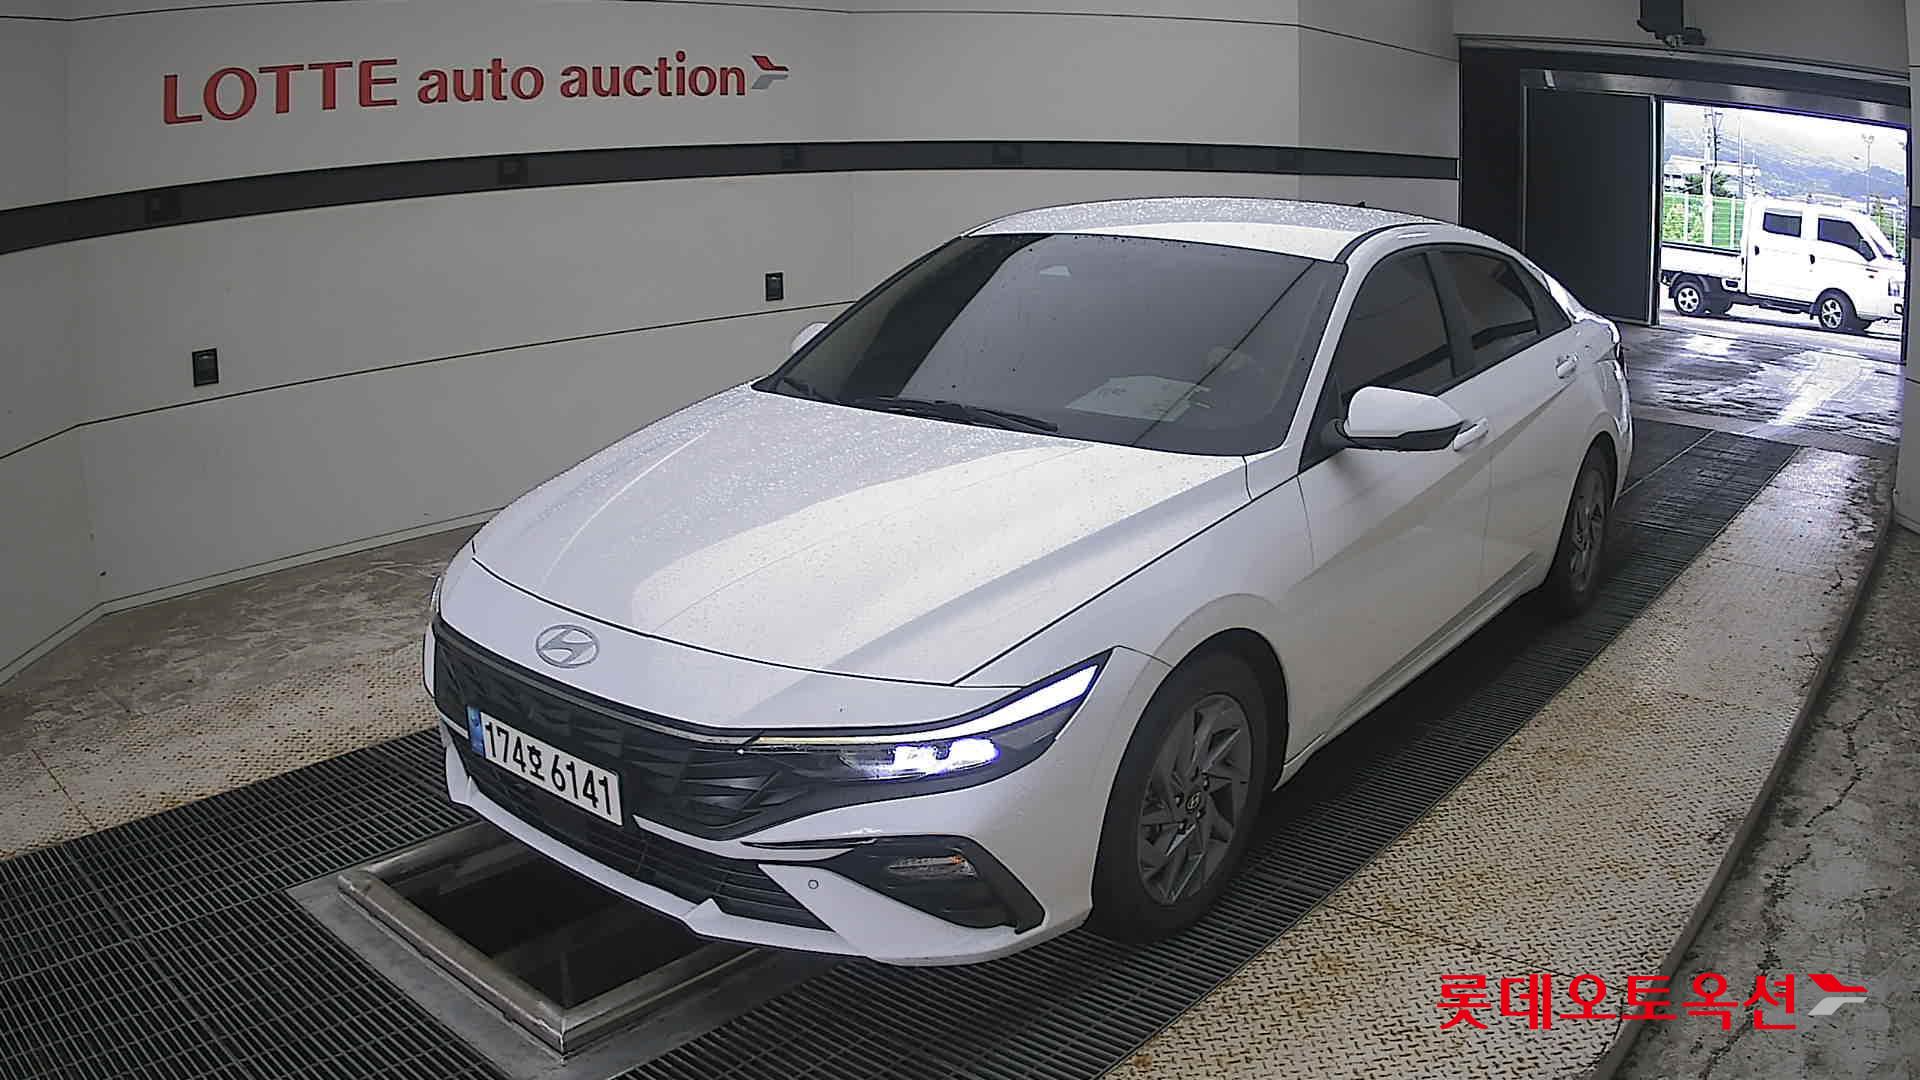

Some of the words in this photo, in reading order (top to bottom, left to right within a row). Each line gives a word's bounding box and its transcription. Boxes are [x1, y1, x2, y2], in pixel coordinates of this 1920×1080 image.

[163, 58, 398, 125] LOTTE
[417, 58, 545, 104] auto
[559, 50, 747, 98] auction
[550, 754, 612, 816] 6141
